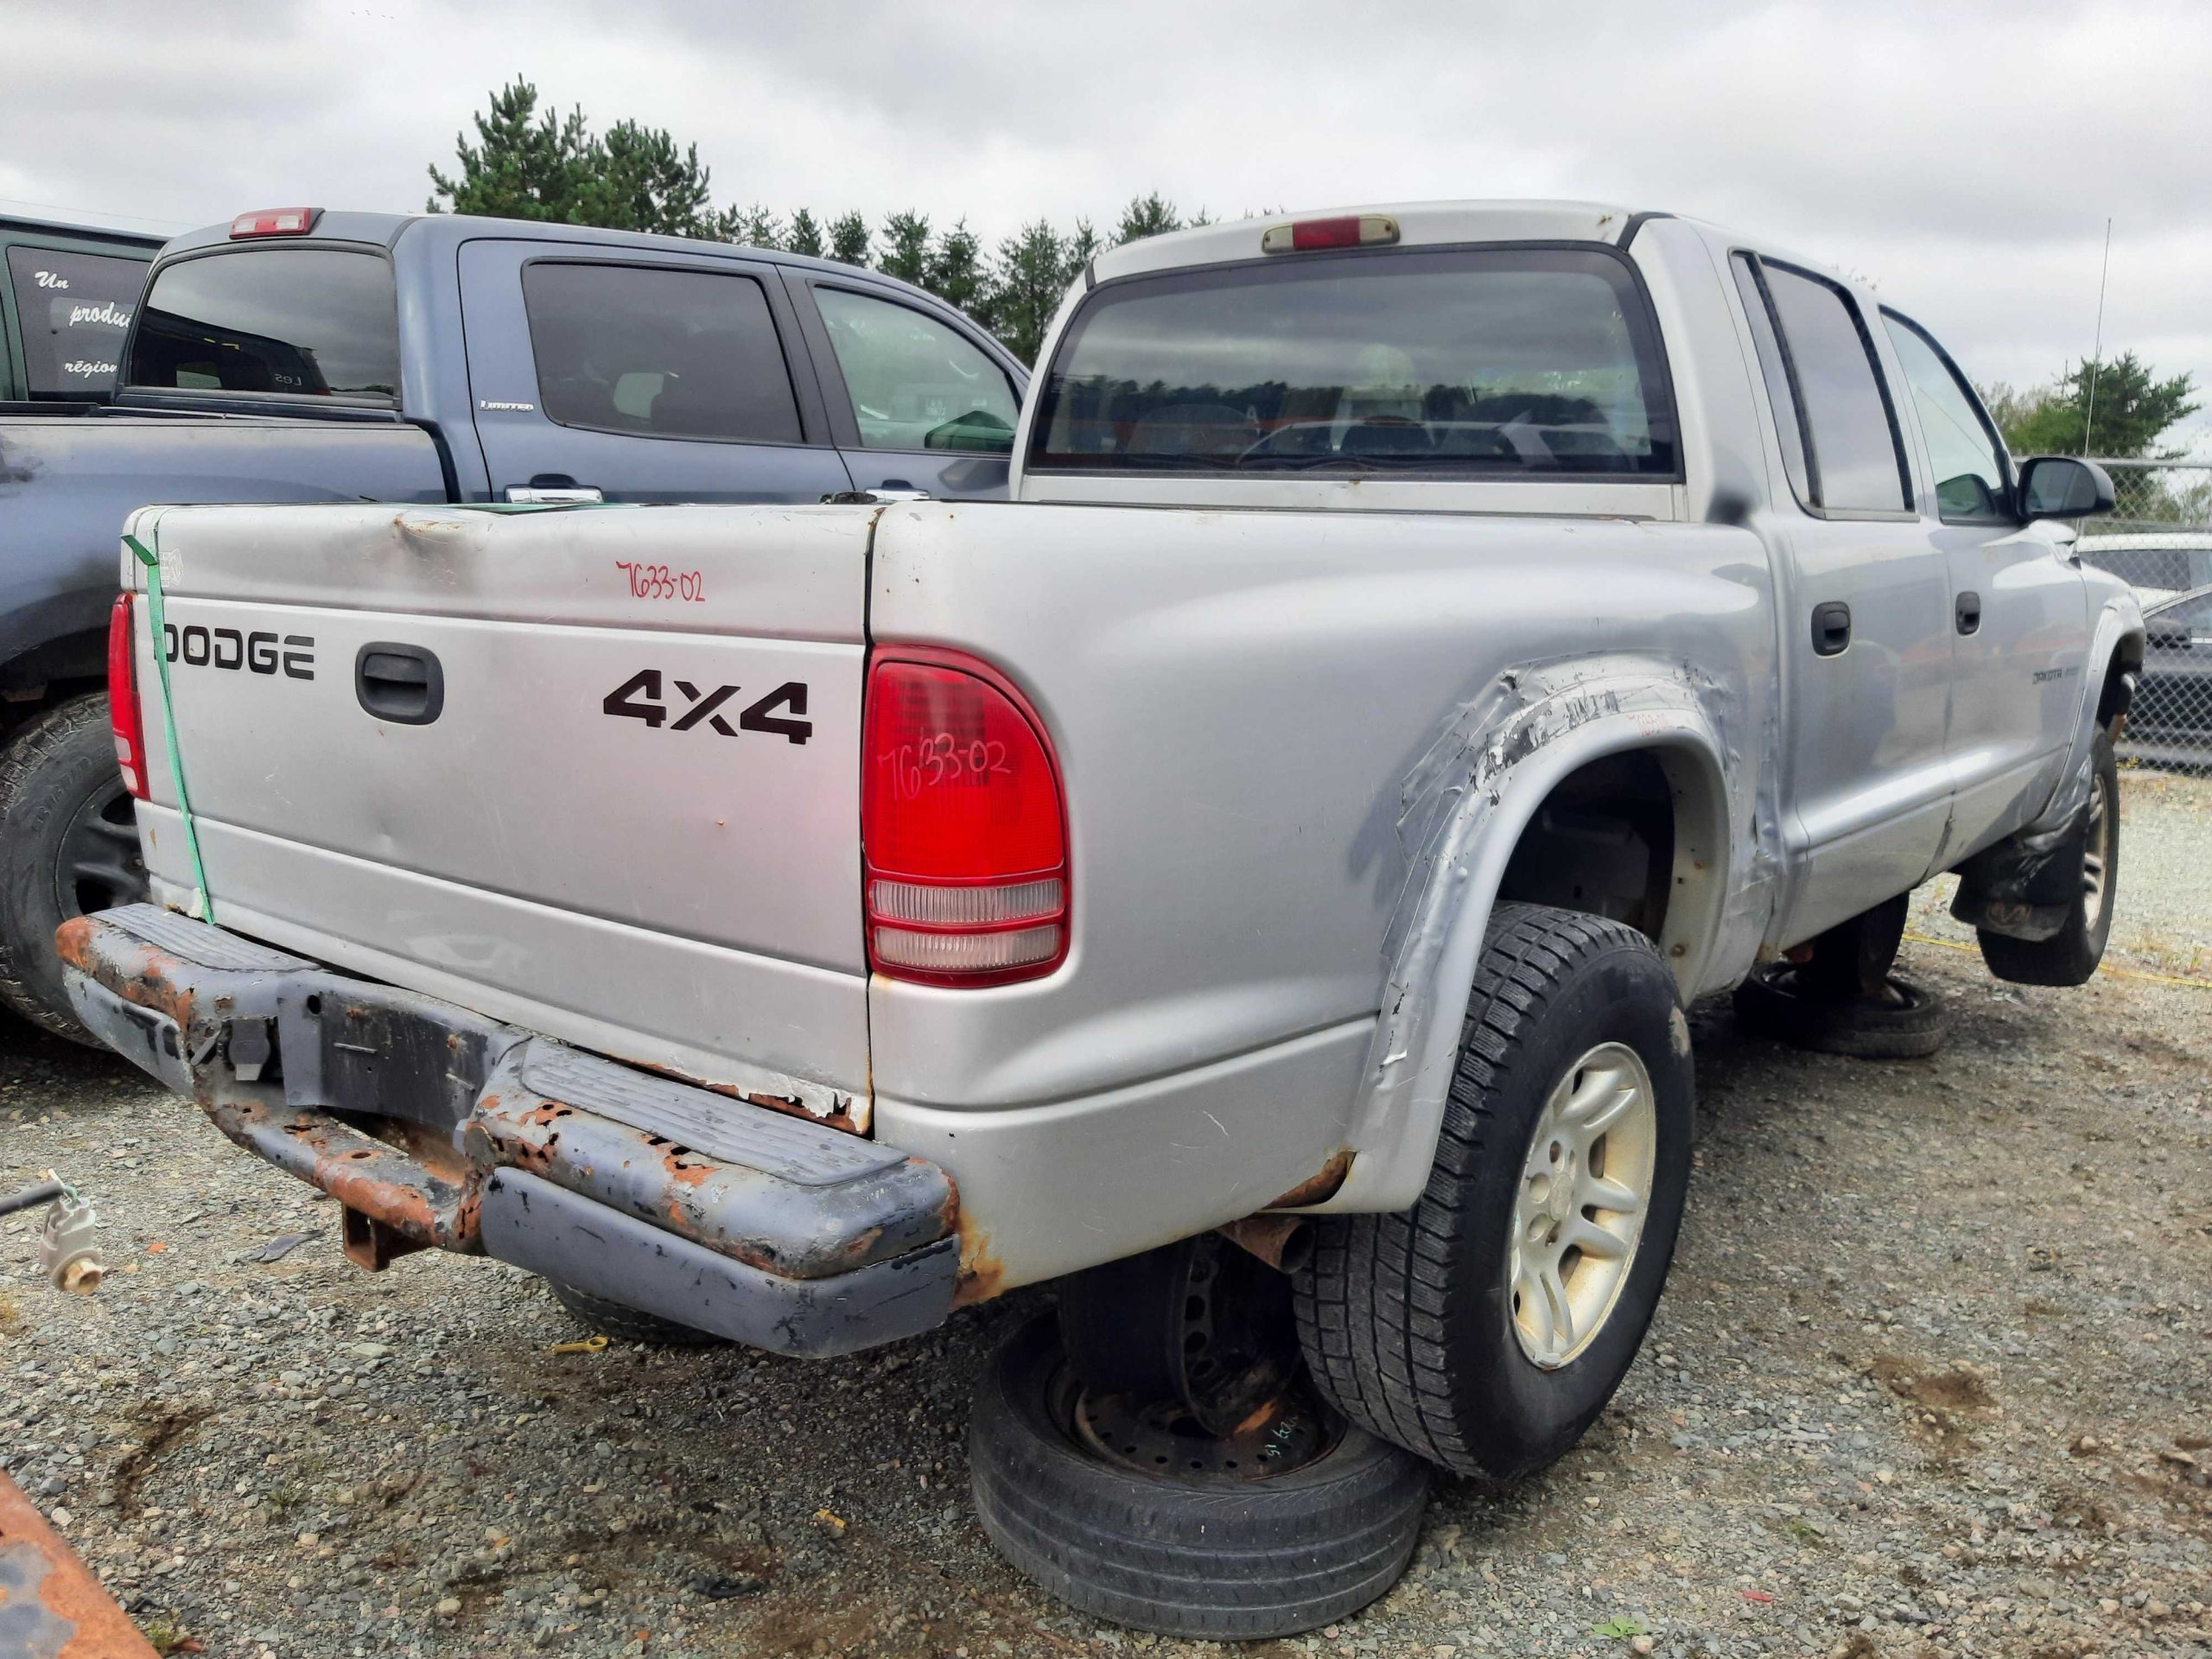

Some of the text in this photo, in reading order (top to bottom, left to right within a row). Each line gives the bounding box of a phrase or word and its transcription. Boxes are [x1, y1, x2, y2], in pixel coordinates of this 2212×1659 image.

[34, 270, 71, 289] Un
[616, 559, 706, 603] 7633-02
[876, 731, 1013, 800] 7633-02
